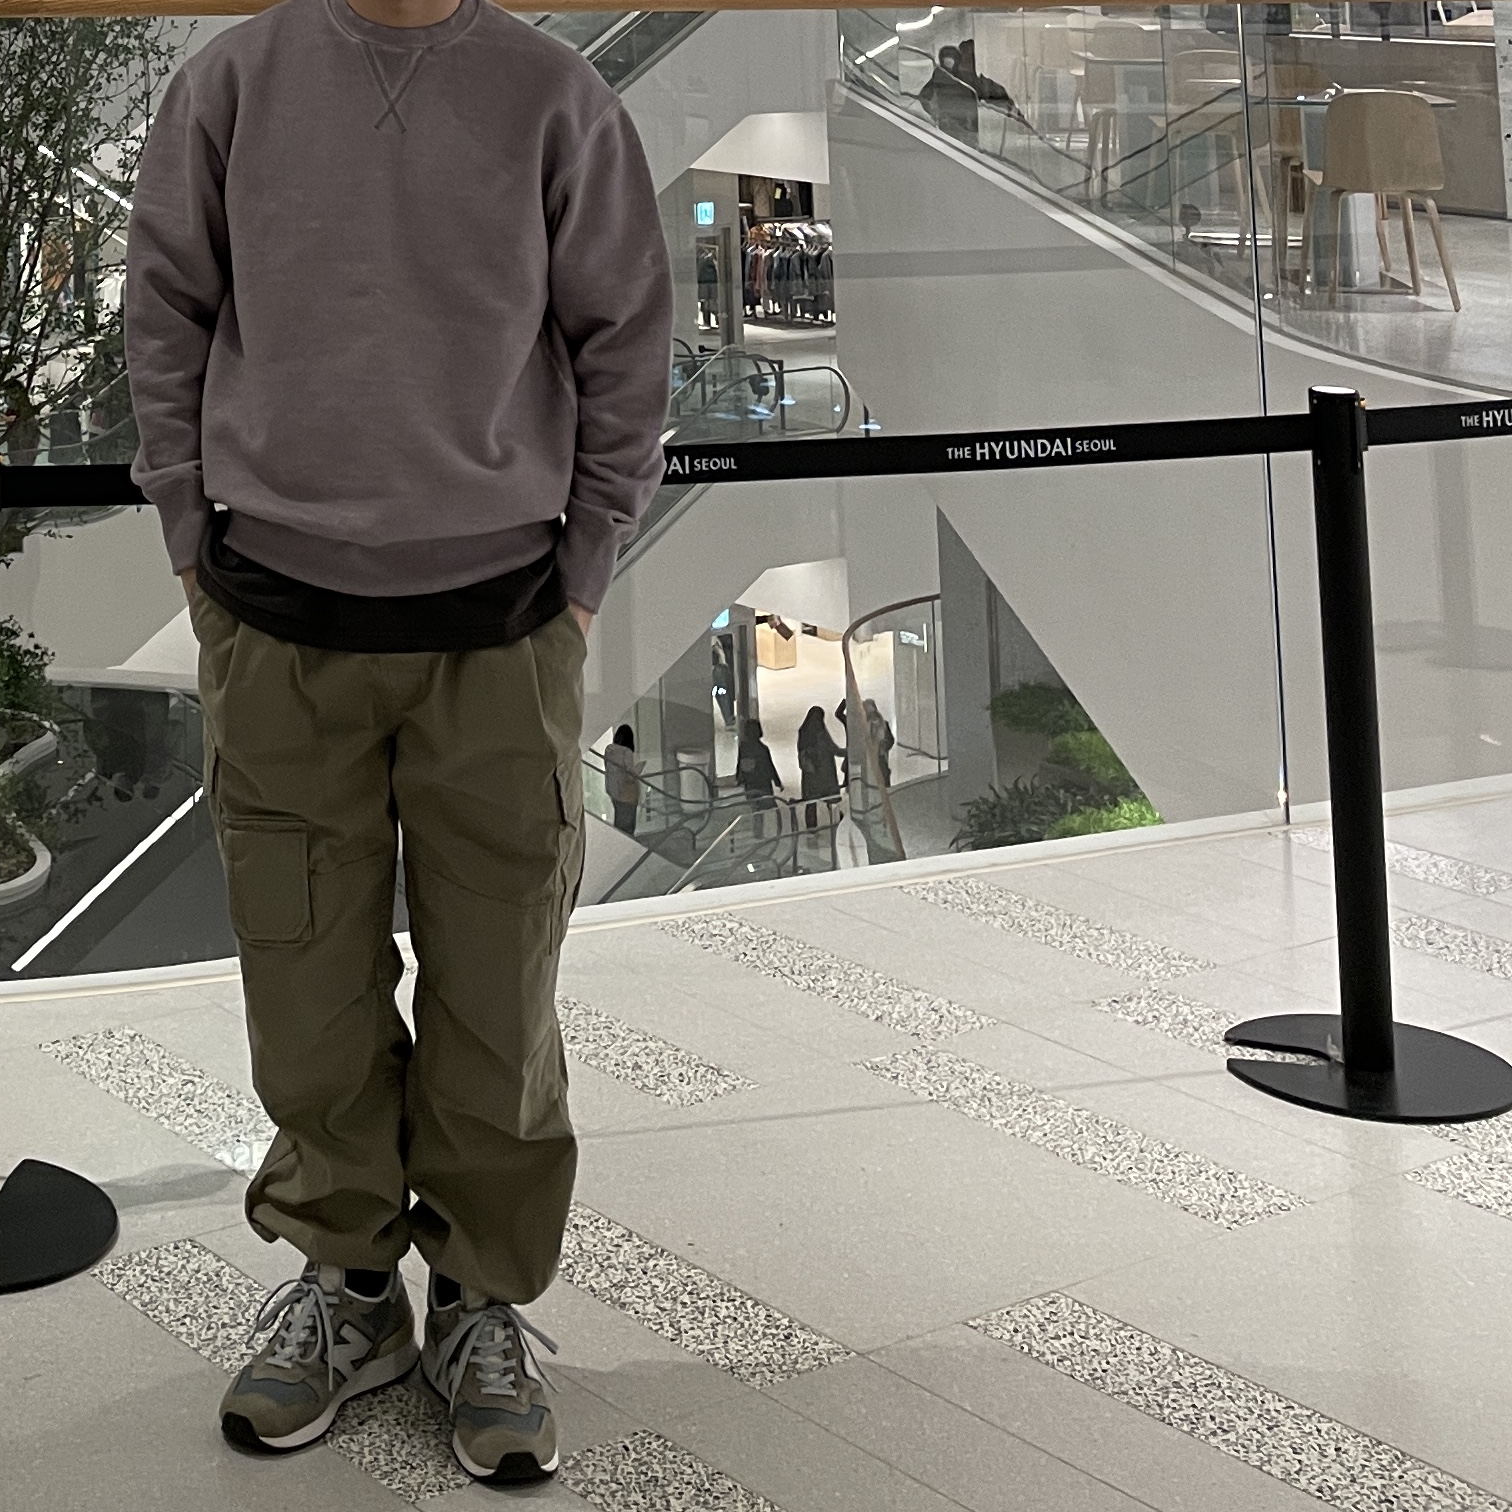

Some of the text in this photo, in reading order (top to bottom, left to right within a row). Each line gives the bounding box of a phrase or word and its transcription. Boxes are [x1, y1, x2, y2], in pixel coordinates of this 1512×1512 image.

[1460, 414, 1481, 427] THE
[946, 437, 1117, 461] THE HYUNDAI SEOUL
[693, 457, 738, 471] SEOUL
